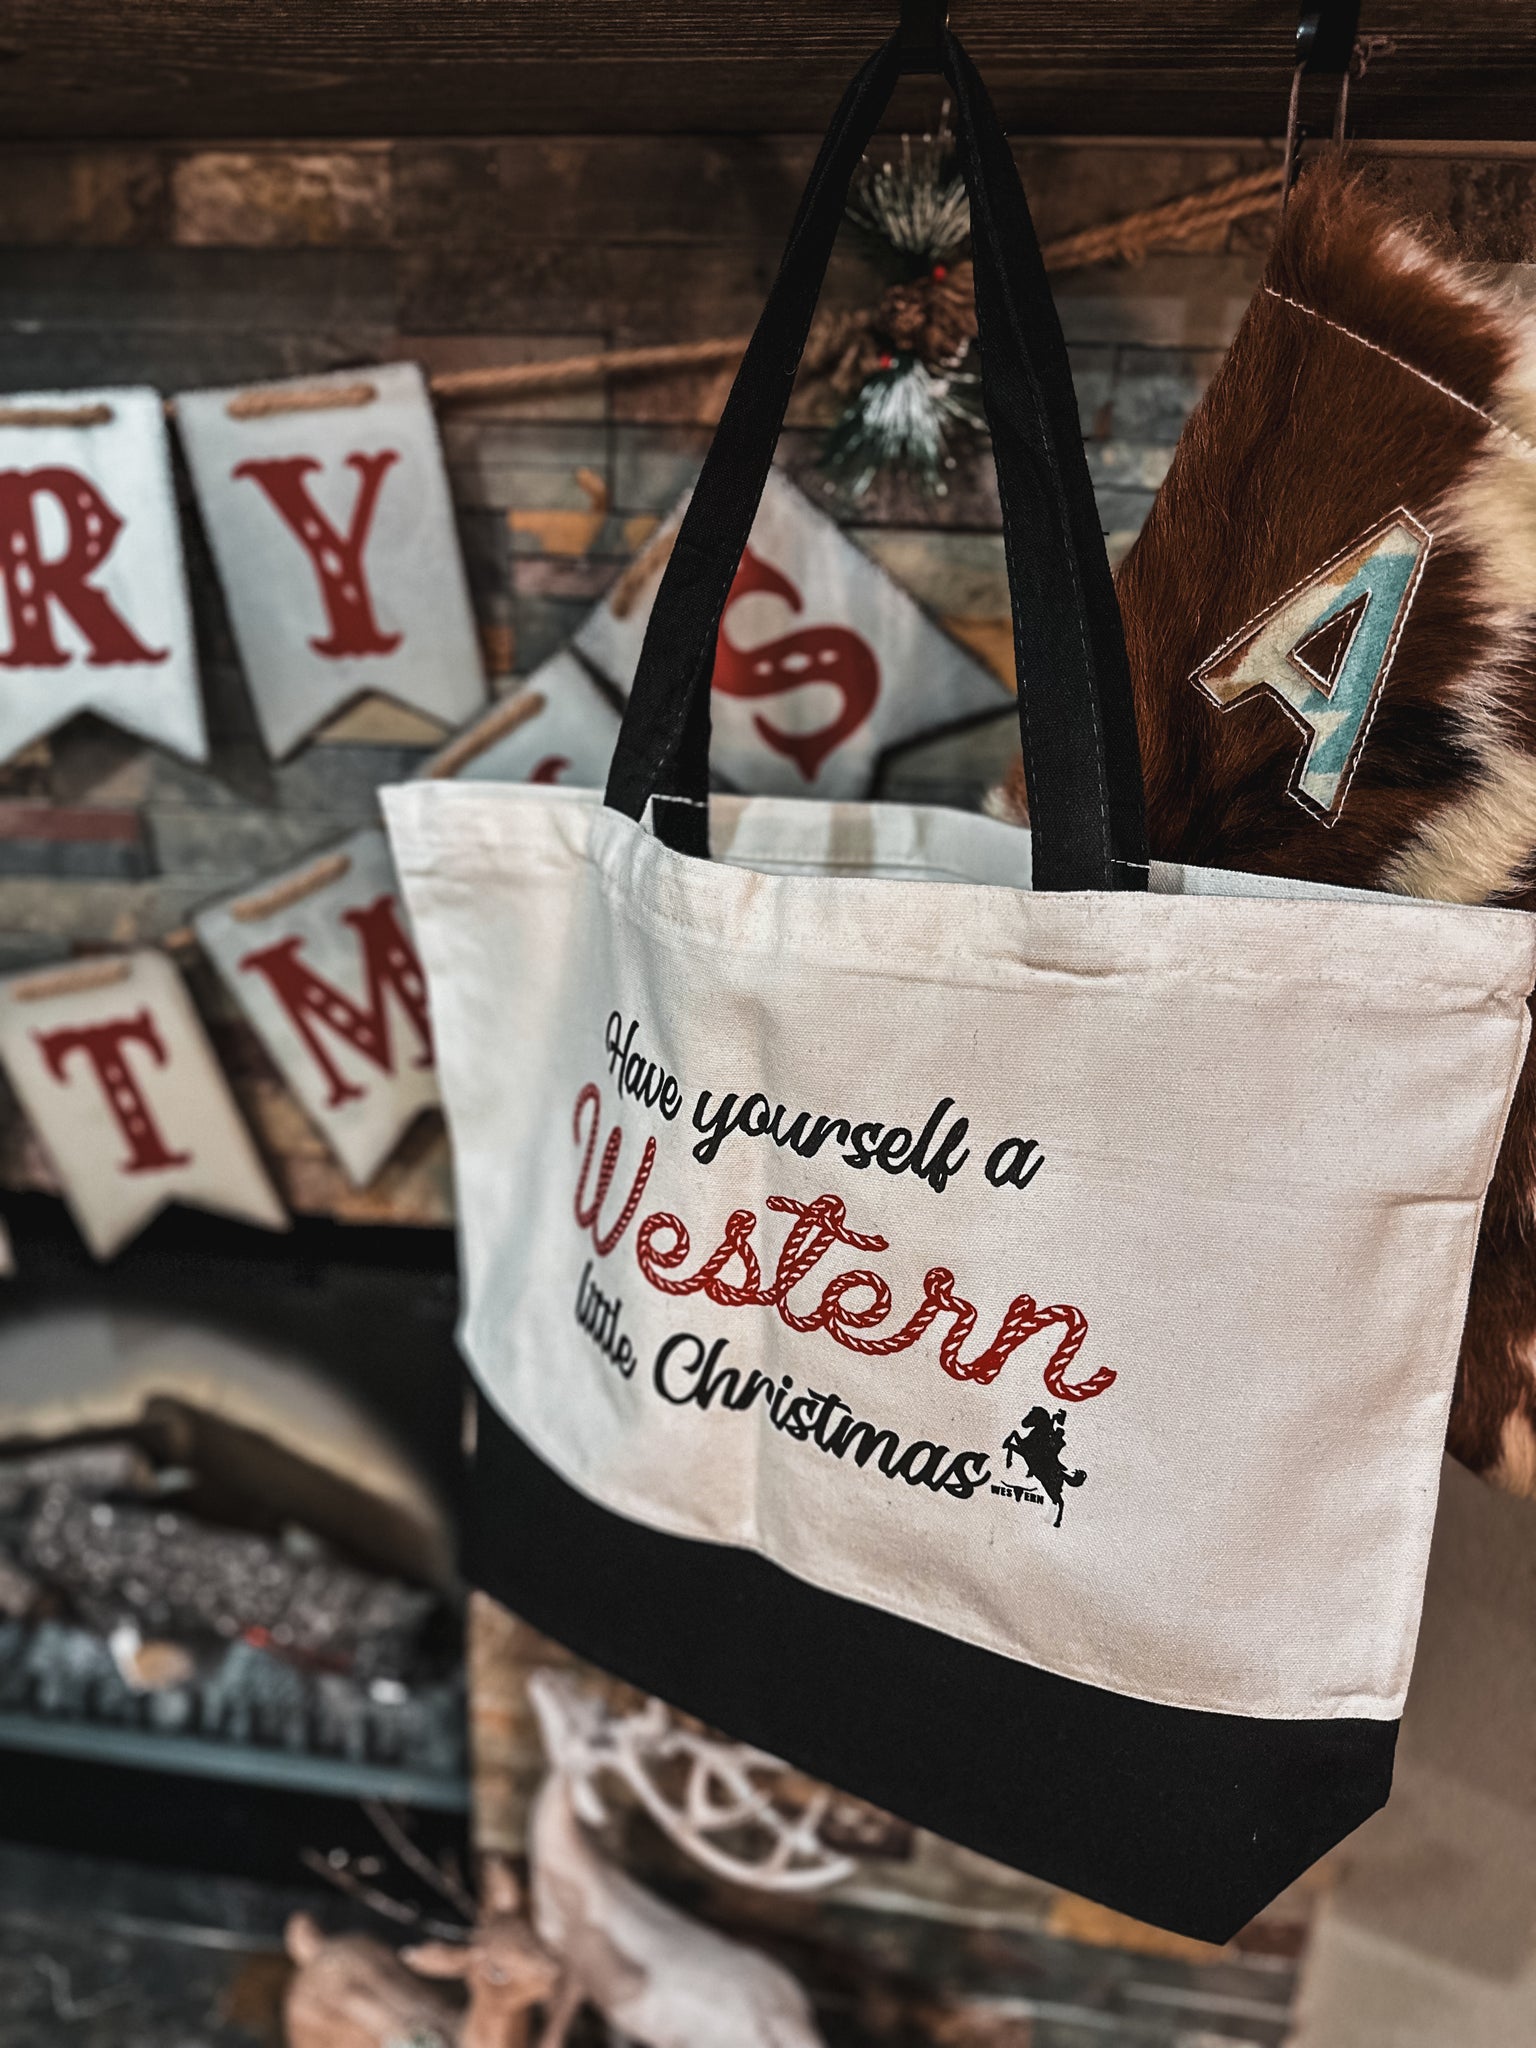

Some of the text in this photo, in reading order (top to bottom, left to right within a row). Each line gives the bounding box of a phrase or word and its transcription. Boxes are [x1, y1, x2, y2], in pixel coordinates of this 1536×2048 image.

[1192, 508, 1430, 826] A
[605, 1011, 1045, 1193] Have yourself a
[573, 1082, 1117, 1402] Western
[653, 1332, 991, 1499] Christmas
